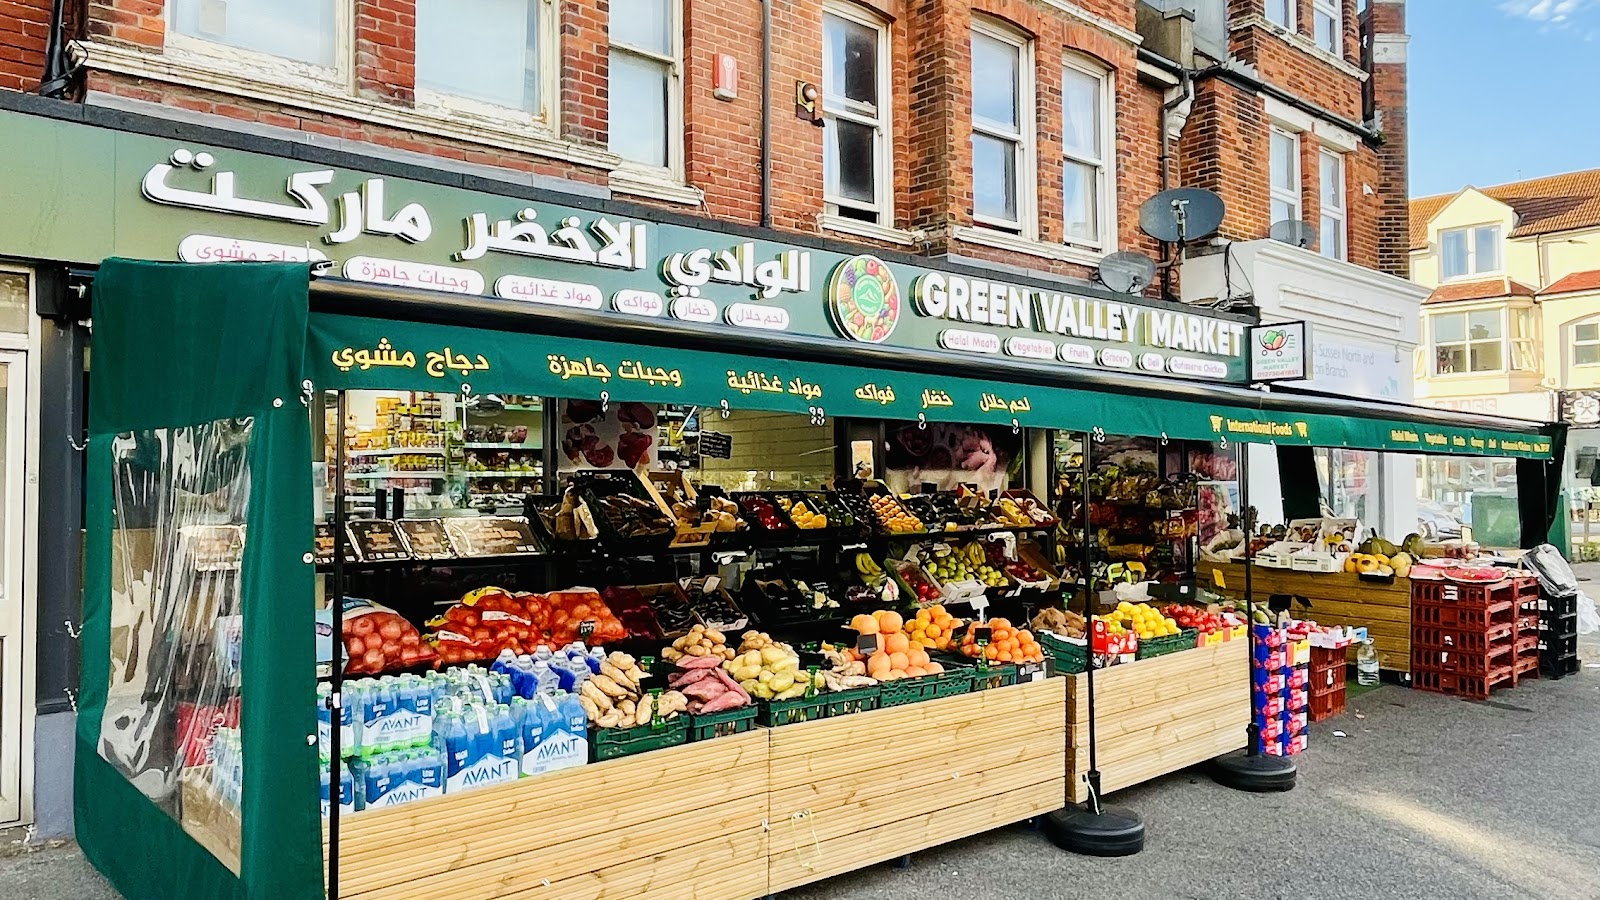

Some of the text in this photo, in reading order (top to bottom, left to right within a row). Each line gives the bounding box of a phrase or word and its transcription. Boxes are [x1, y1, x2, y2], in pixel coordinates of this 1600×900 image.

[142, 149, 432, 244] ماركت
[361, 261, 468, 292] وجبات جاهزة
[660, 243, 811, 299] الوادي
[510, 279, 592, 303] مواد غذائية
[623, 296, 658, 311] فواكه
[682, 301, 711, 317] خضار
[736, 308, 784, 325] لحم حلال
[916, 271, 1244, 357] GREEN VALLEY MARKET
[948, 335, 997, 349] Halal Meats
[1012, 341, 1053, 355] Vegetables
[331, 338, 490, 377] دجاج مشوي
[1069, 347, 1089, 359] Fruits
[1104, 353, 1130, 365] Grocery
[546, 354, 682, 387] وجبات جاهزة
[727, 370, 822, 400] مواد غذائية
[855, 384, 895, 405] فواكه
[922, 389, 953, 409] خضار
[979, 393, 1031, 413] لحم حلال
[1227, 419, 1293, 436] International Foods
[381, 715, 422, 733] AVANT
[537, 737, 580, 761] AVANT
[462, 760, 512, 786] AVANT
[385, 787, 428, 806] AVANT
